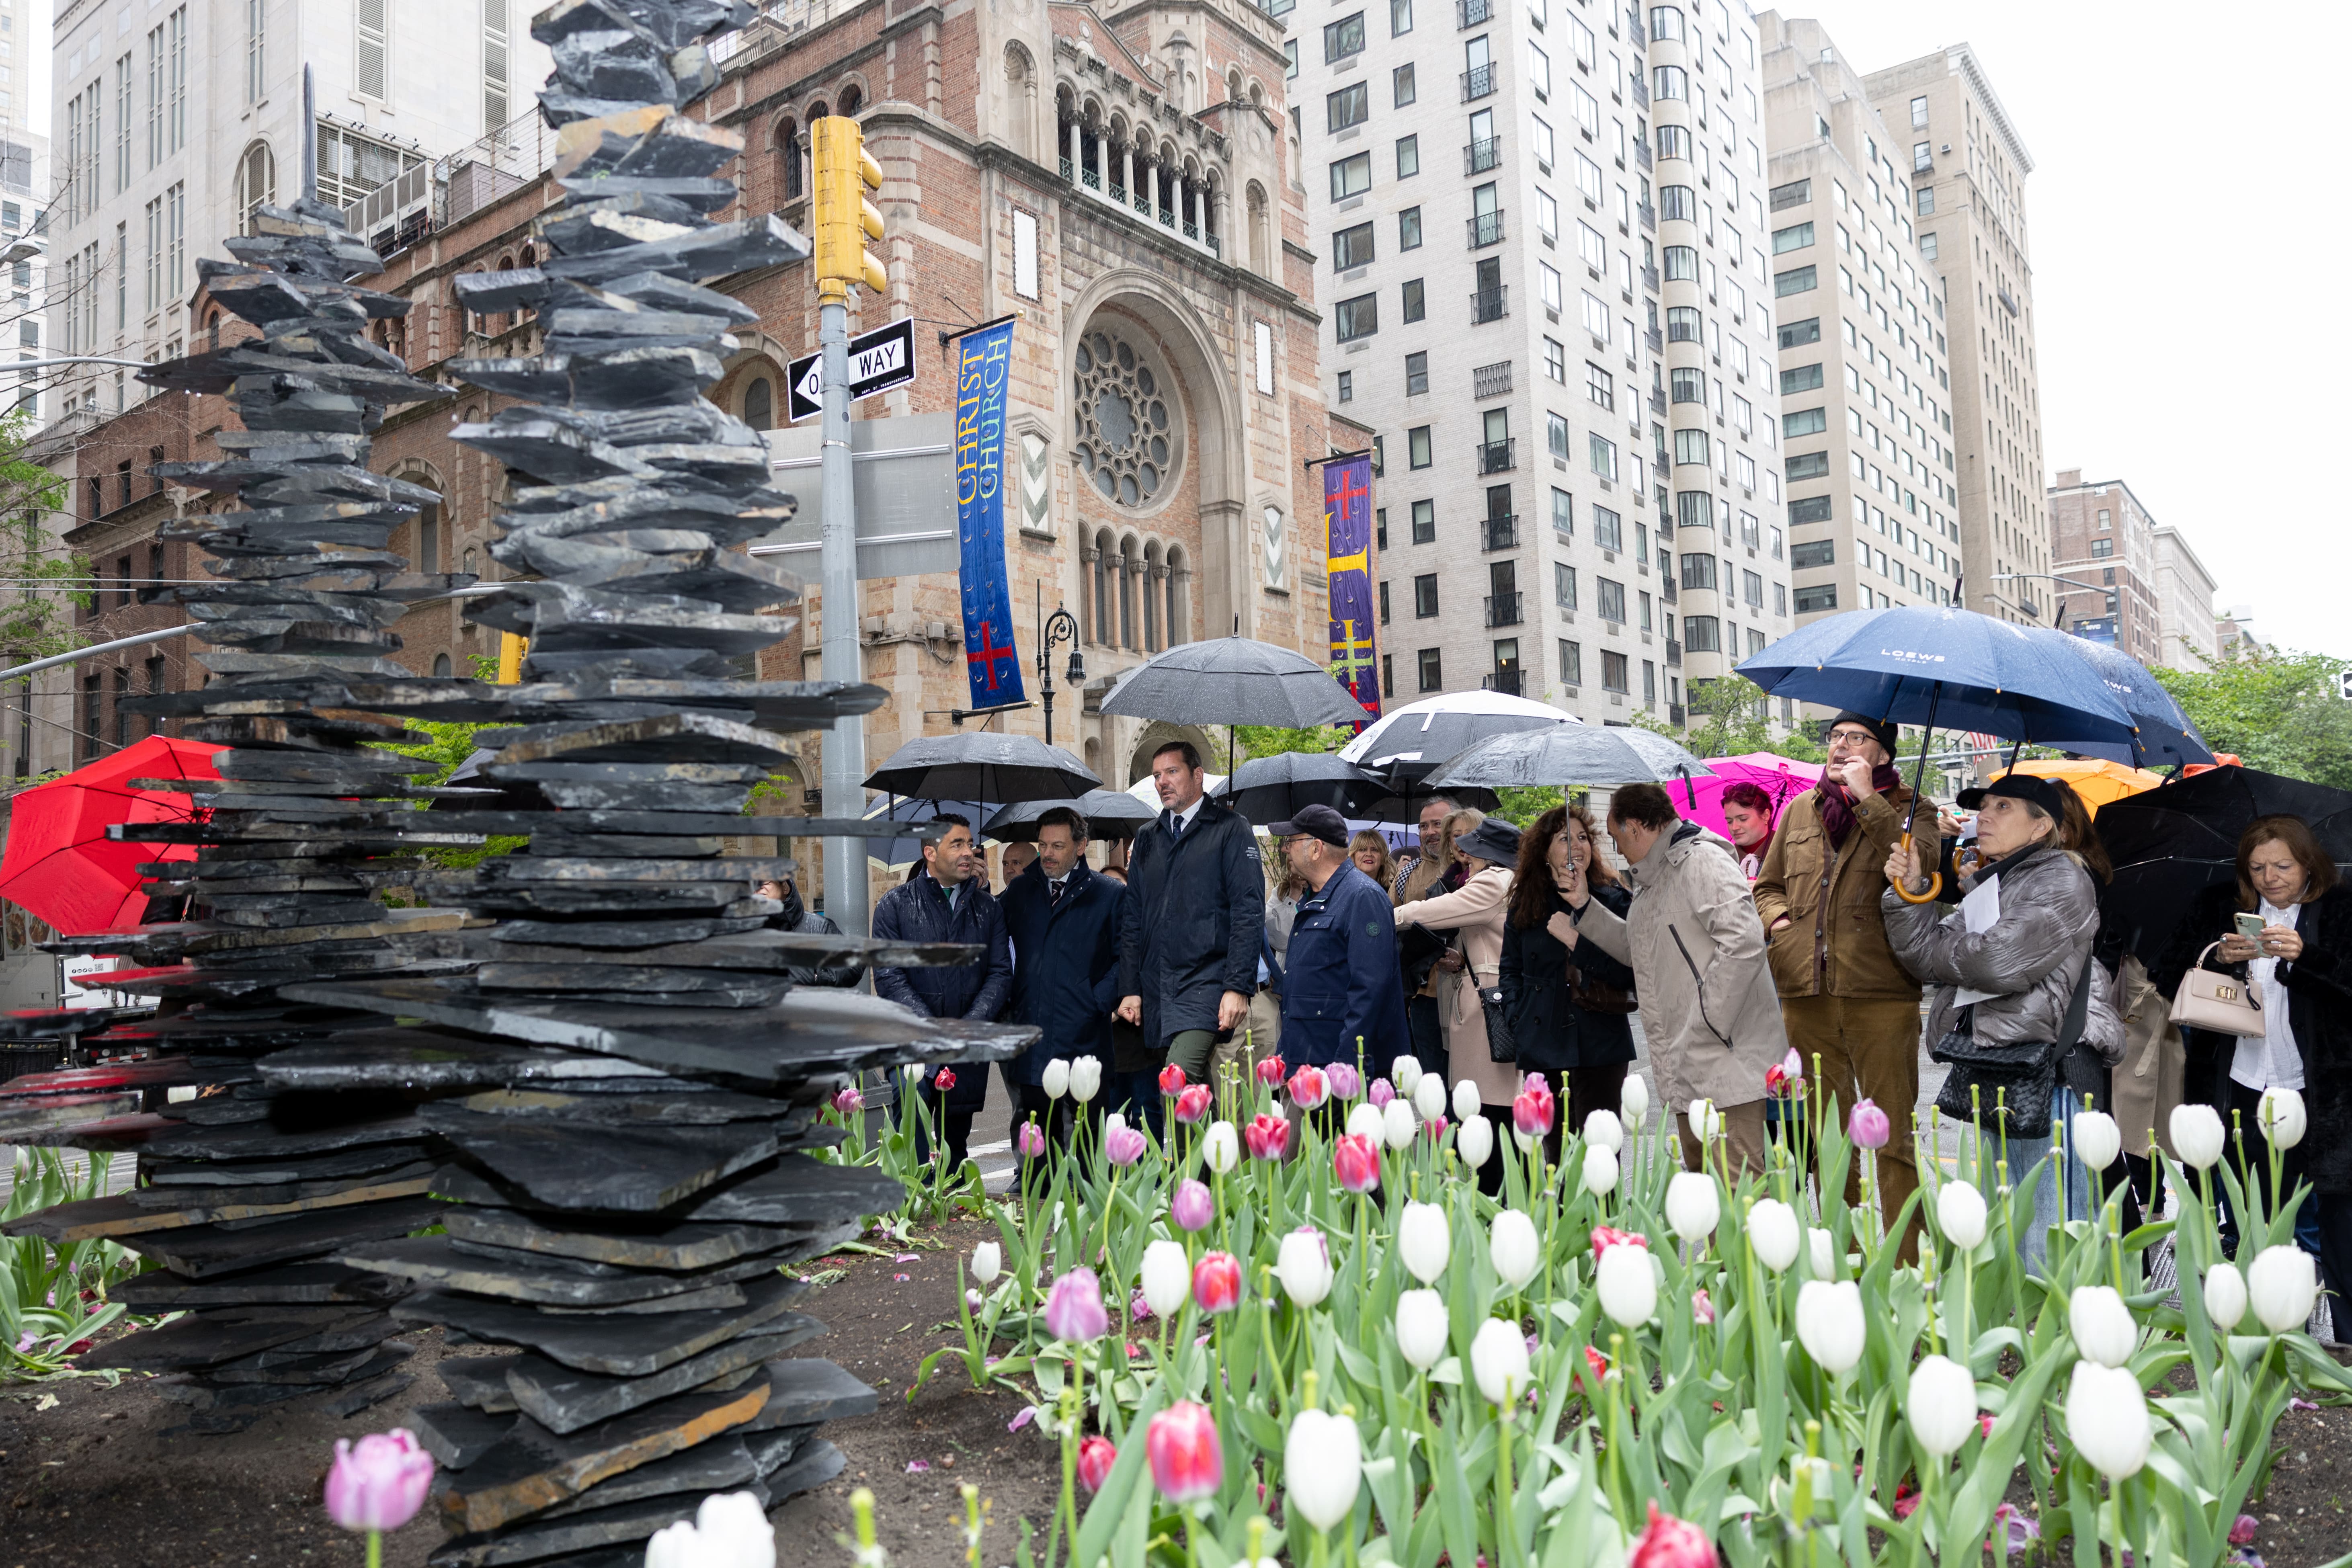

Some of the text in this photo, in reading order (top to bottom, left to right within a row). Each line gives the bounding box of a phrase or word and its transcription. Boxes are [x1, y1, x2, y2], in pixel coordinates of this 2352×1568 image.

[859, 343, 896, 377] WAY
[880, 375, 909, 387] TRANSPORTATION
[958, 348, 985, 505] CHRIST
[979, 335, 1008, 499] CHURCH
[1881, 648, 1945, 662] LOEWS
